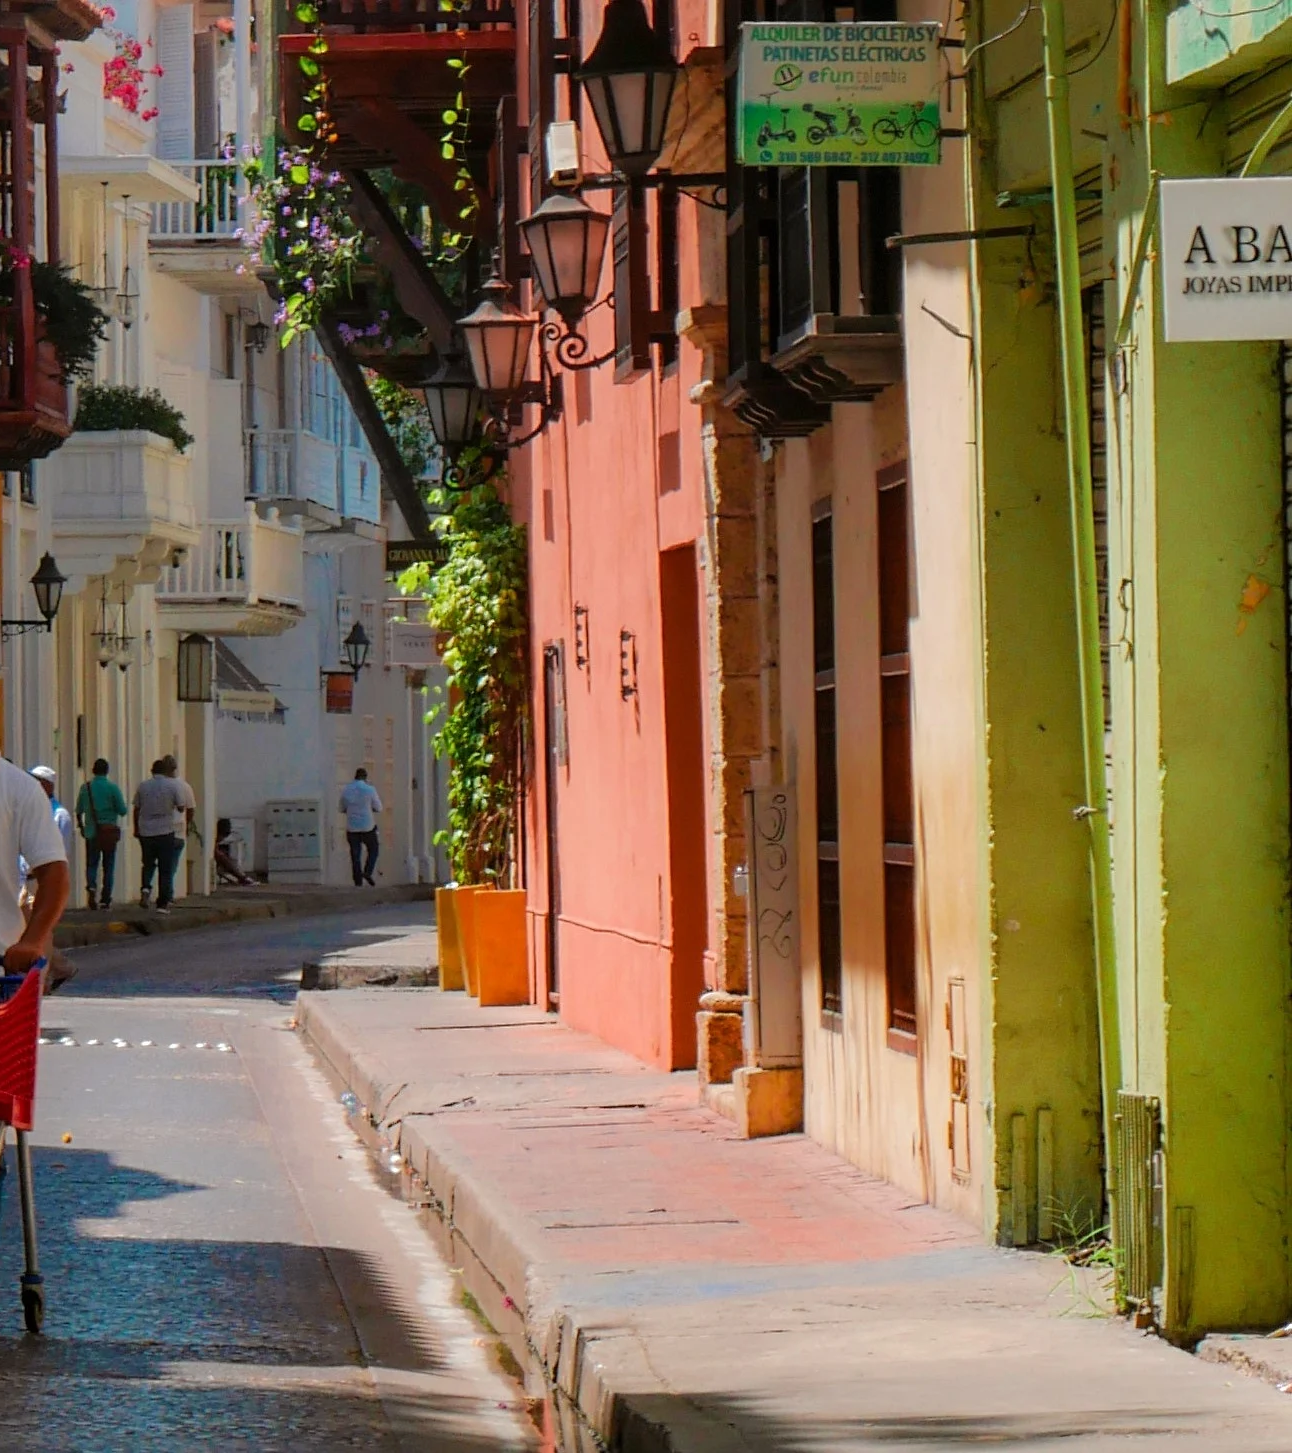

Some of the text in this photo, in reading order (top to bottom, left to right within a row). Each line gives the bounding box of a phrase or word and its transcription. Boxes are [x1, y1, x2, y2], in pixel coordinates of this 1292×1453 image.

[751, 26, 936, 42] ALQUILER DE BICICLETAS Y
[763, 44, 926, 62] PATINETAS ELÉCTRICAS
[808, 67, 854, 83] efun
[1184, 224, 1218, 264] A
[1182, 276, 1242, 295] JOYAS
